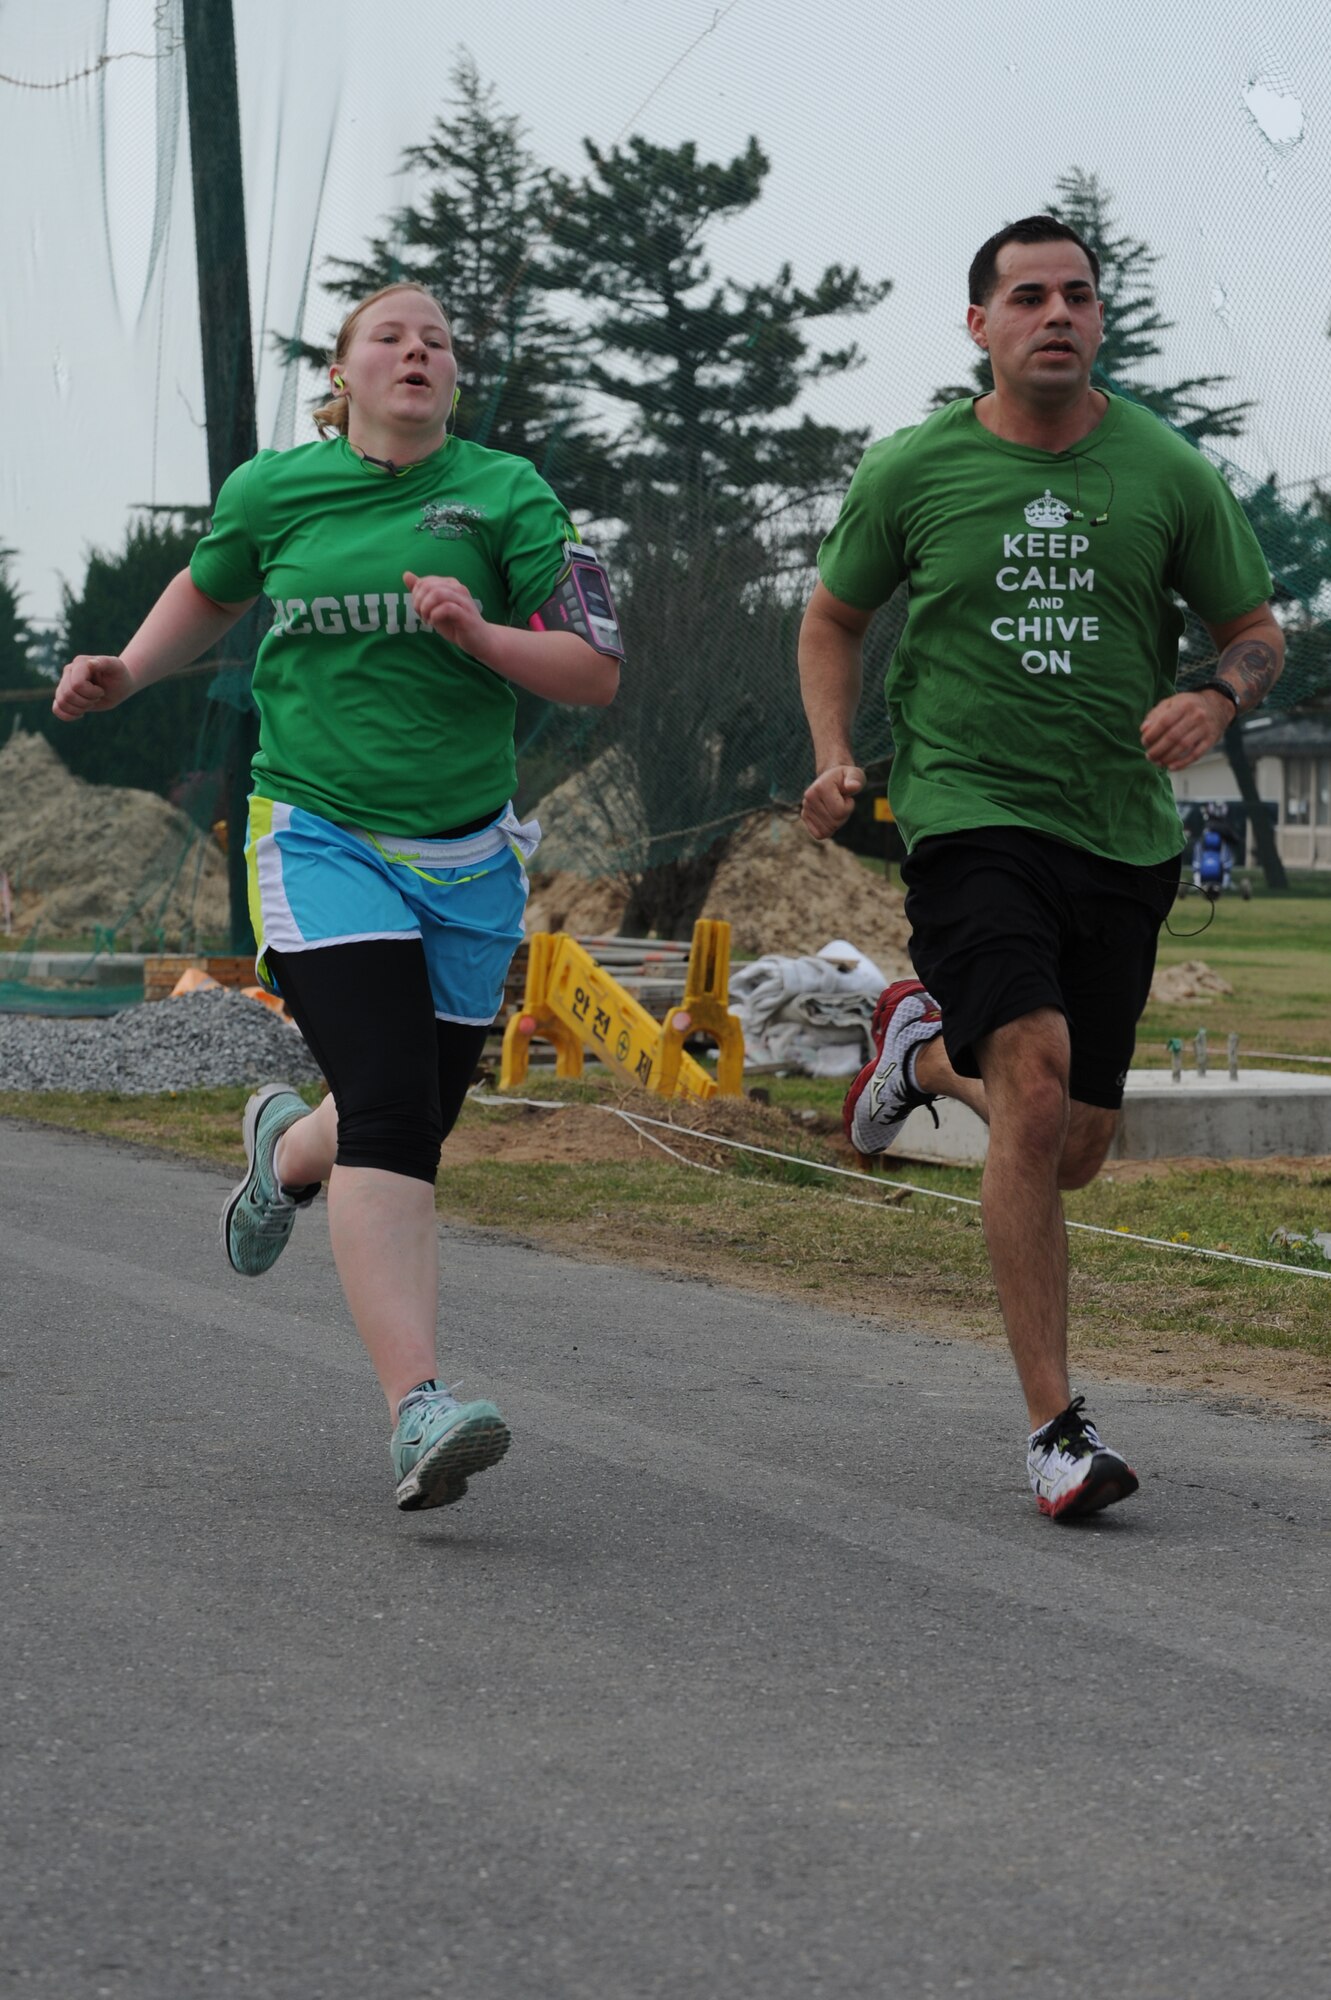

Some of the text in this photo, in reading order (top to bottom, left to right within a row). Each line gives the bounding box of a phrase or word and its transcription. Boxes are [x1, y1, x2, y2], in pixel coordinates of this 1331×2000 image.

[1003, 533, 1090, 559] KEEP
[995, 566, 1095, 592] CALM
[1027, 597, 1064, 610] AND
[990, 616, 1100, 642] CHIVE
[1021, 650, 1072, 675] ON
[572, 987, 611, 1043] 안전
